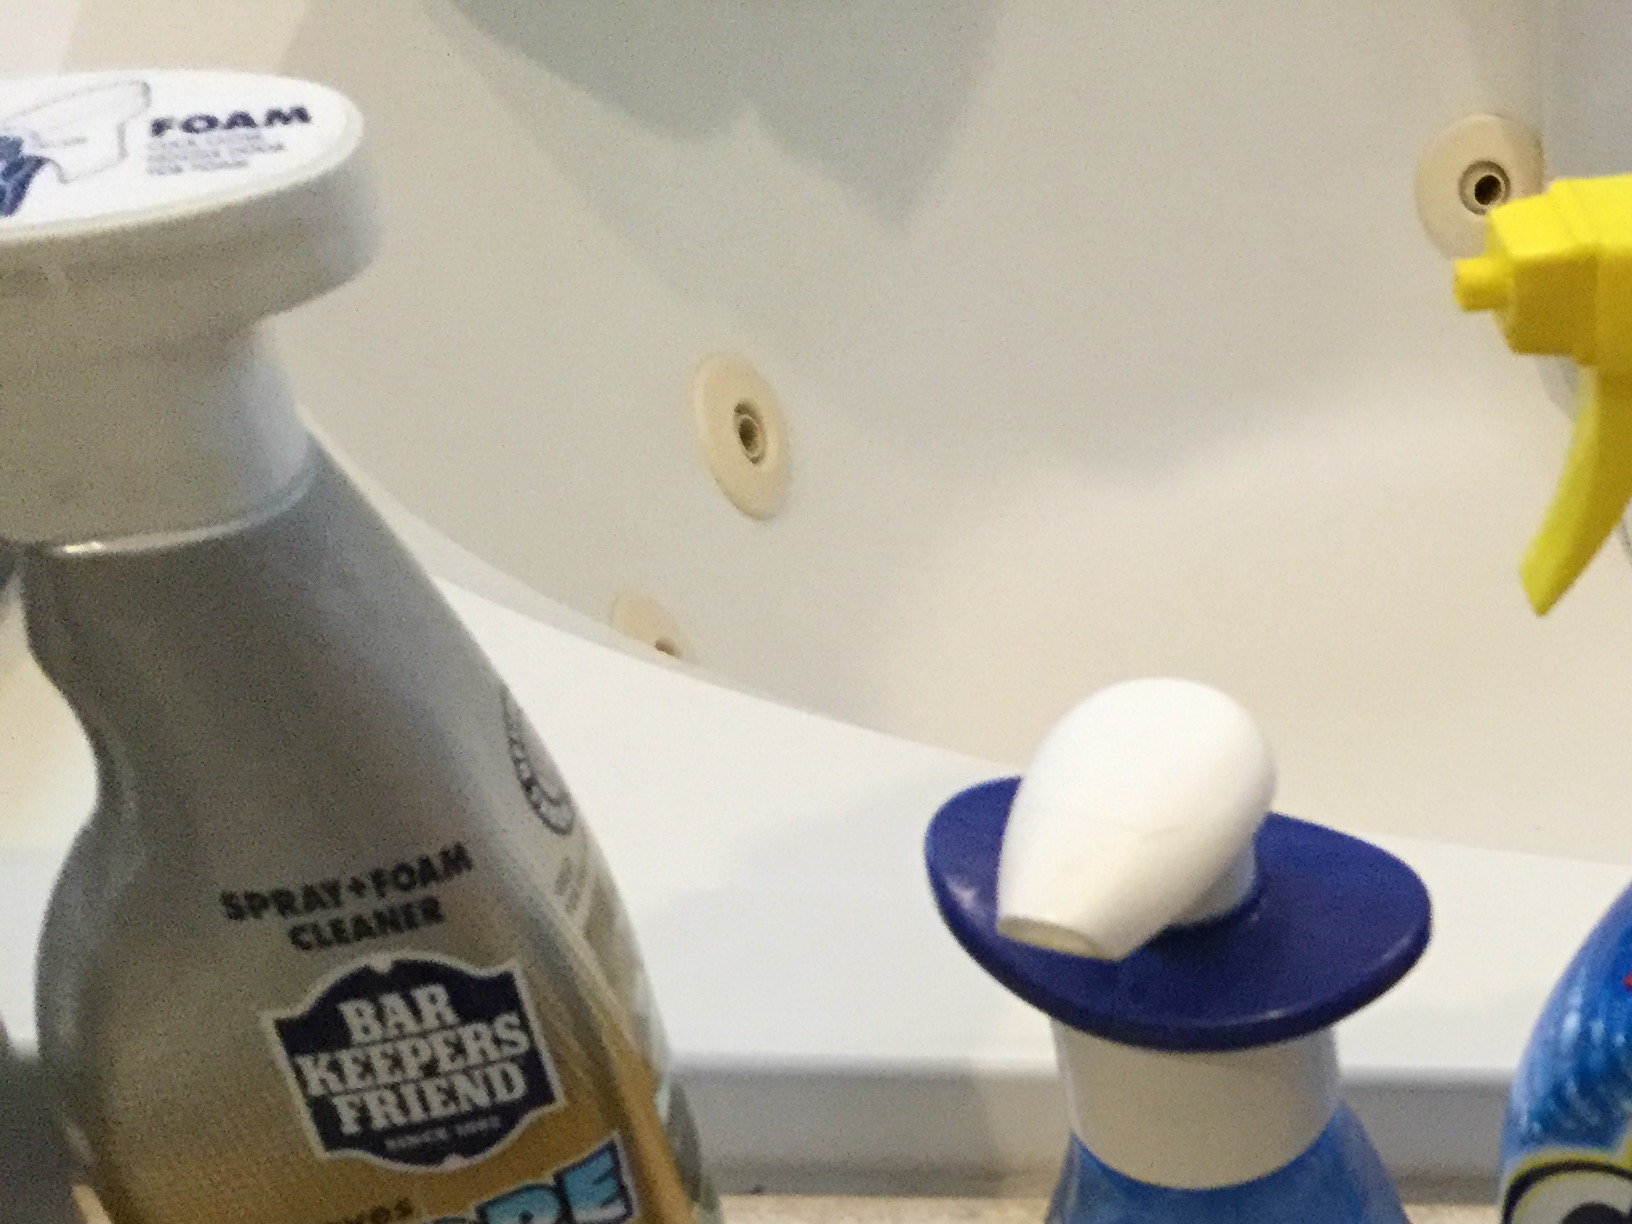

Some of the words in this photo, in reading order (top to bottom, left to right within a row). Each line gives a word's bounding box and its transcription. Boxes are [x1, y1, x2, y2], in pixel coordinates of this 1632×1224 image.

[150, 106, 311, 137] FOAM
[288, 896, 443, 950] CLEANER
[338, 983, 460, 1043] BAR
[298, 1012, 530, 1098] KEEPERS
[331, 1061, 528, 1135] FRIEND
